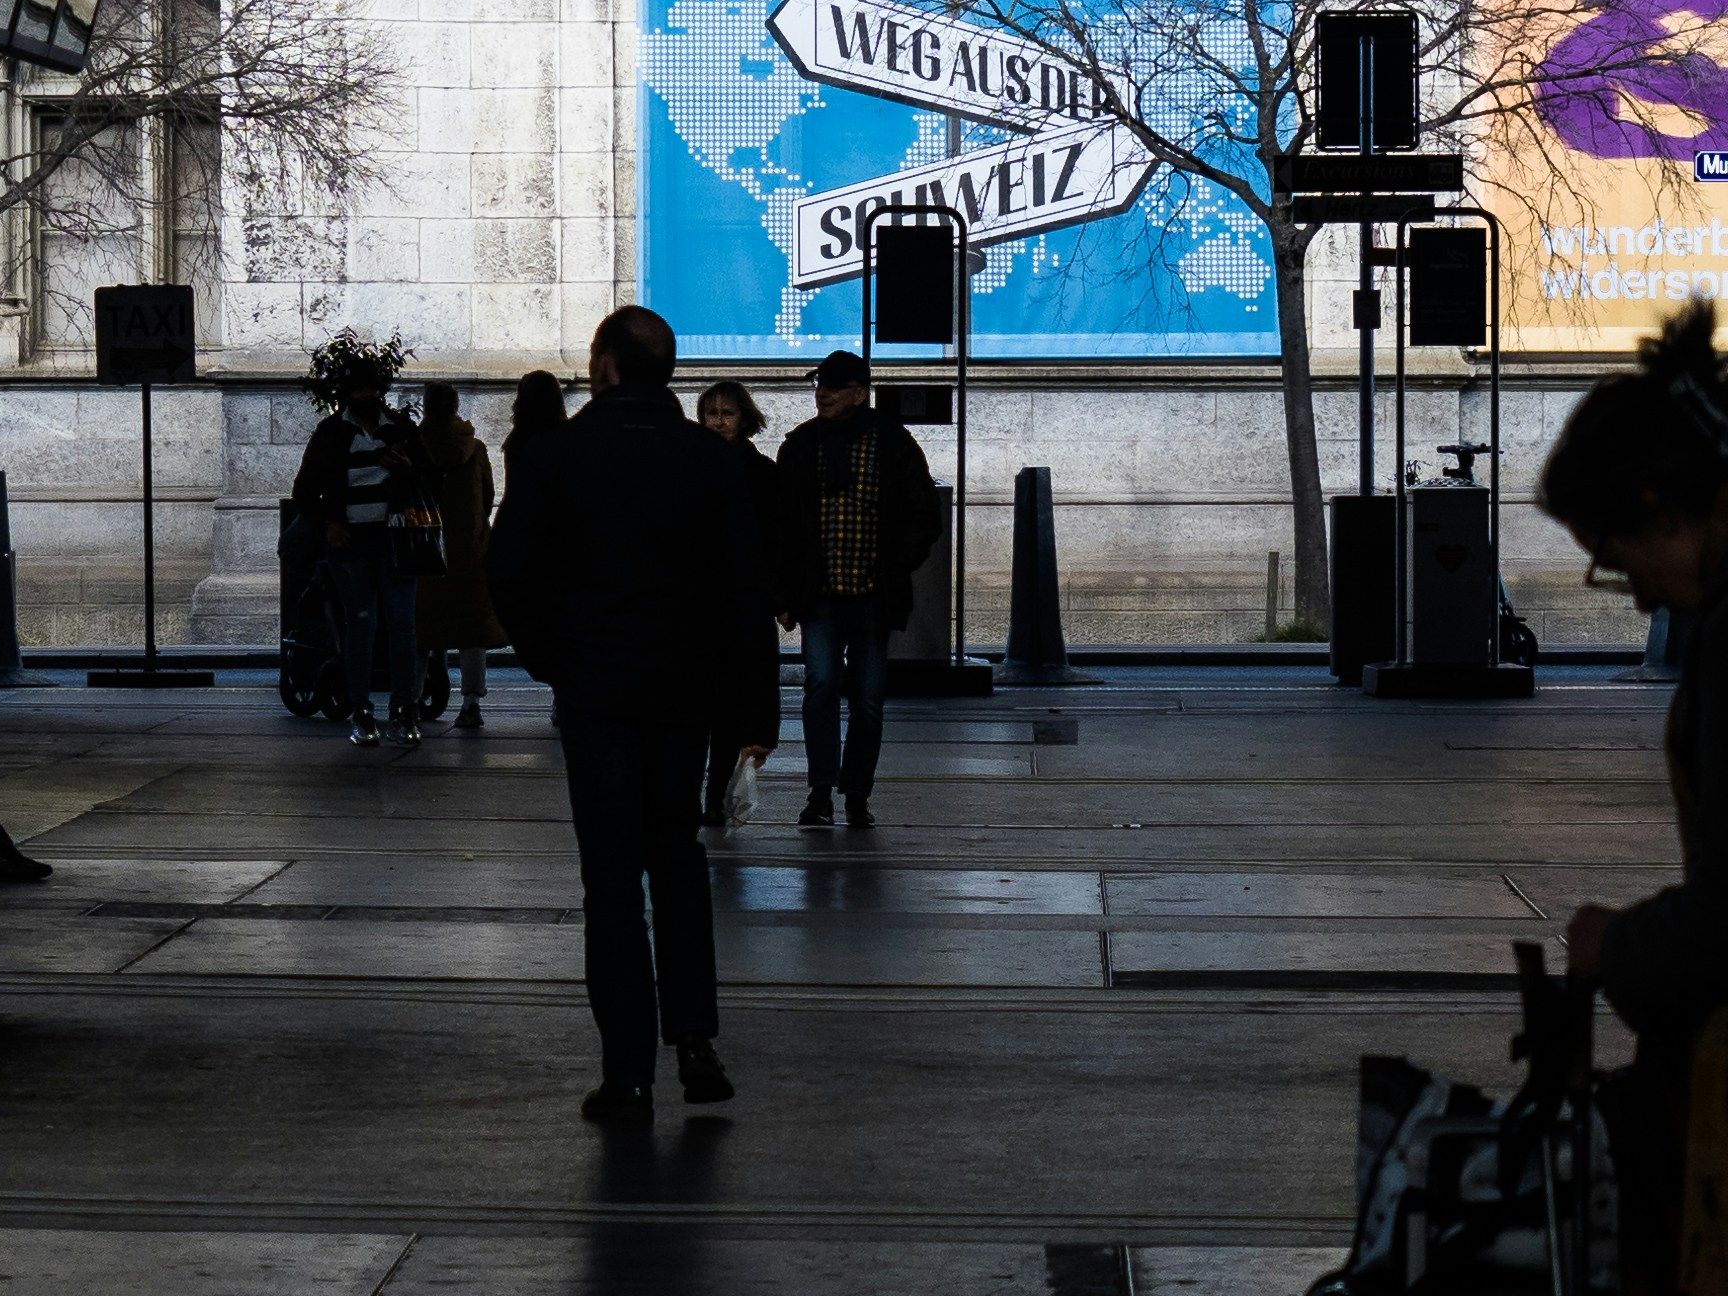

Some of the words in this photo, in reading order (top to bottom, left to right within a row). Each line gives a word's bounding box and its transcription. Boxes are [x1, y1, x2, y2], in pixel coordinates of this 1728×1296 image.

[830, 4, 941, 82] WEG
[948, 40, 1032, 104] AUS
[106, 303, 186, 337] TAXI
